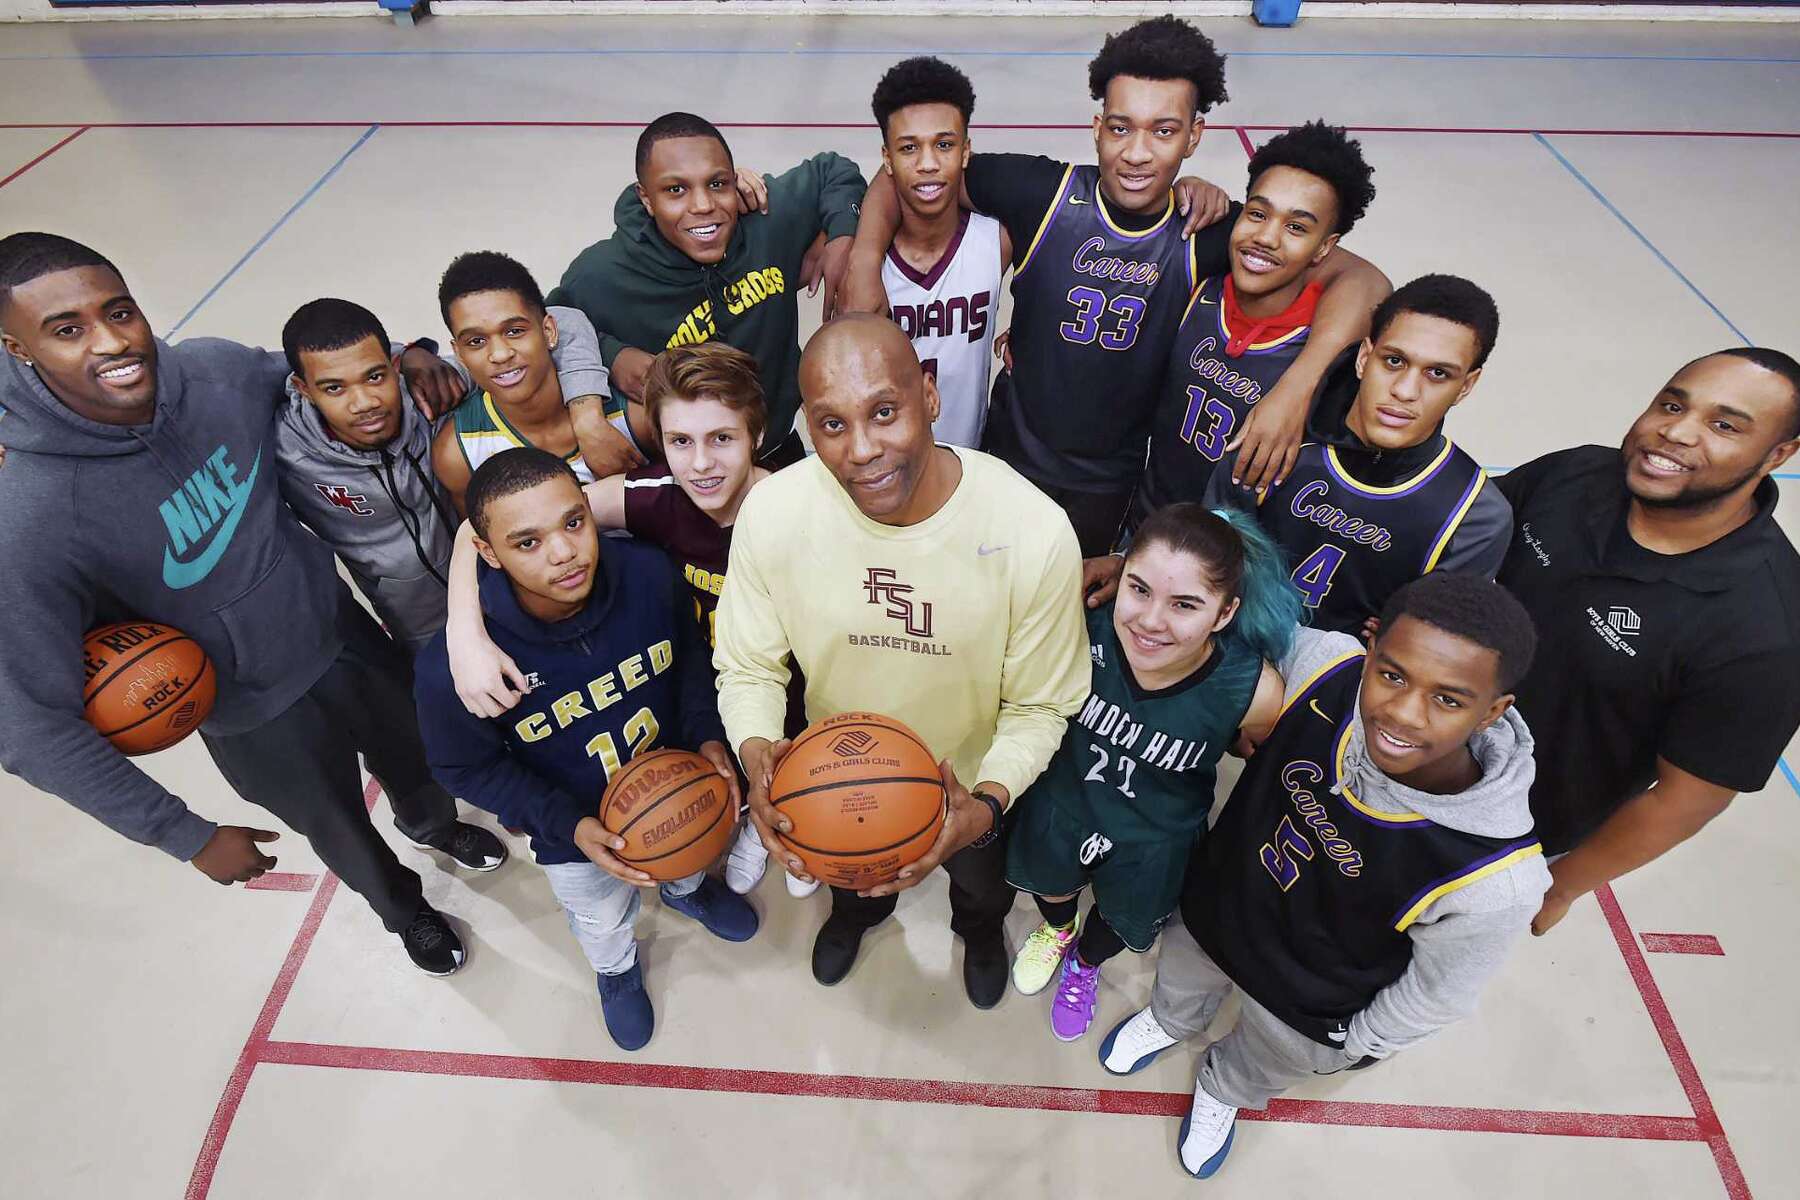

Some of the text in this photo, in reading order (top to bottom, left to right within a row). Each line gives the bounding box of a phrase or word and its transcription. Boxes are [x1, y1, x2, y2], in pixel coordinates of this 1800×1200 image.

[723, 266, 785, 315] CROSS
[1072, 236, 1161, 285] Career
[889, 290, 991, 344] DIANS
[1060, 285, 1148, 351] 33
[1189, 336, 1262, 405] Career
[1179, 384, 1236, 462] 13
[159, 445, 247, 556] NIKE
[314, 483, 375, 517] WC
[1290, 480, 1392, 552] Career
[863, 567, 934, 638] FSU
[1289, 543, 1347, 609] 4
[98, 625, 166, 655] ROCK
[847, 633, 953, 656] BASKETBALL
[1602, 625, 1621, 643] GIRLS
[1618, 641, 1637, 657] CLUB
[142, 675, 185, 710] ROCK
[514, 639, 674, 743] CREED
[823, 713, 874, 727] ROCK
[585, 706, 661, 786] 12
[1076, 693, 1208, 772] MDEN HALL
[611, 760, 699, 815] Wilson
[809, 763, 832, 777] BOYS
[842, 758, 871, 767] GIRLS
[872, 757, 901, 768] CLUBS
[1083, 743, 1138, 799] 22
[641, 788, 717, 848] EVOLUTION
[1281, 760, 1364, 878] Career
[1260, 814, 1315, 893] 5
